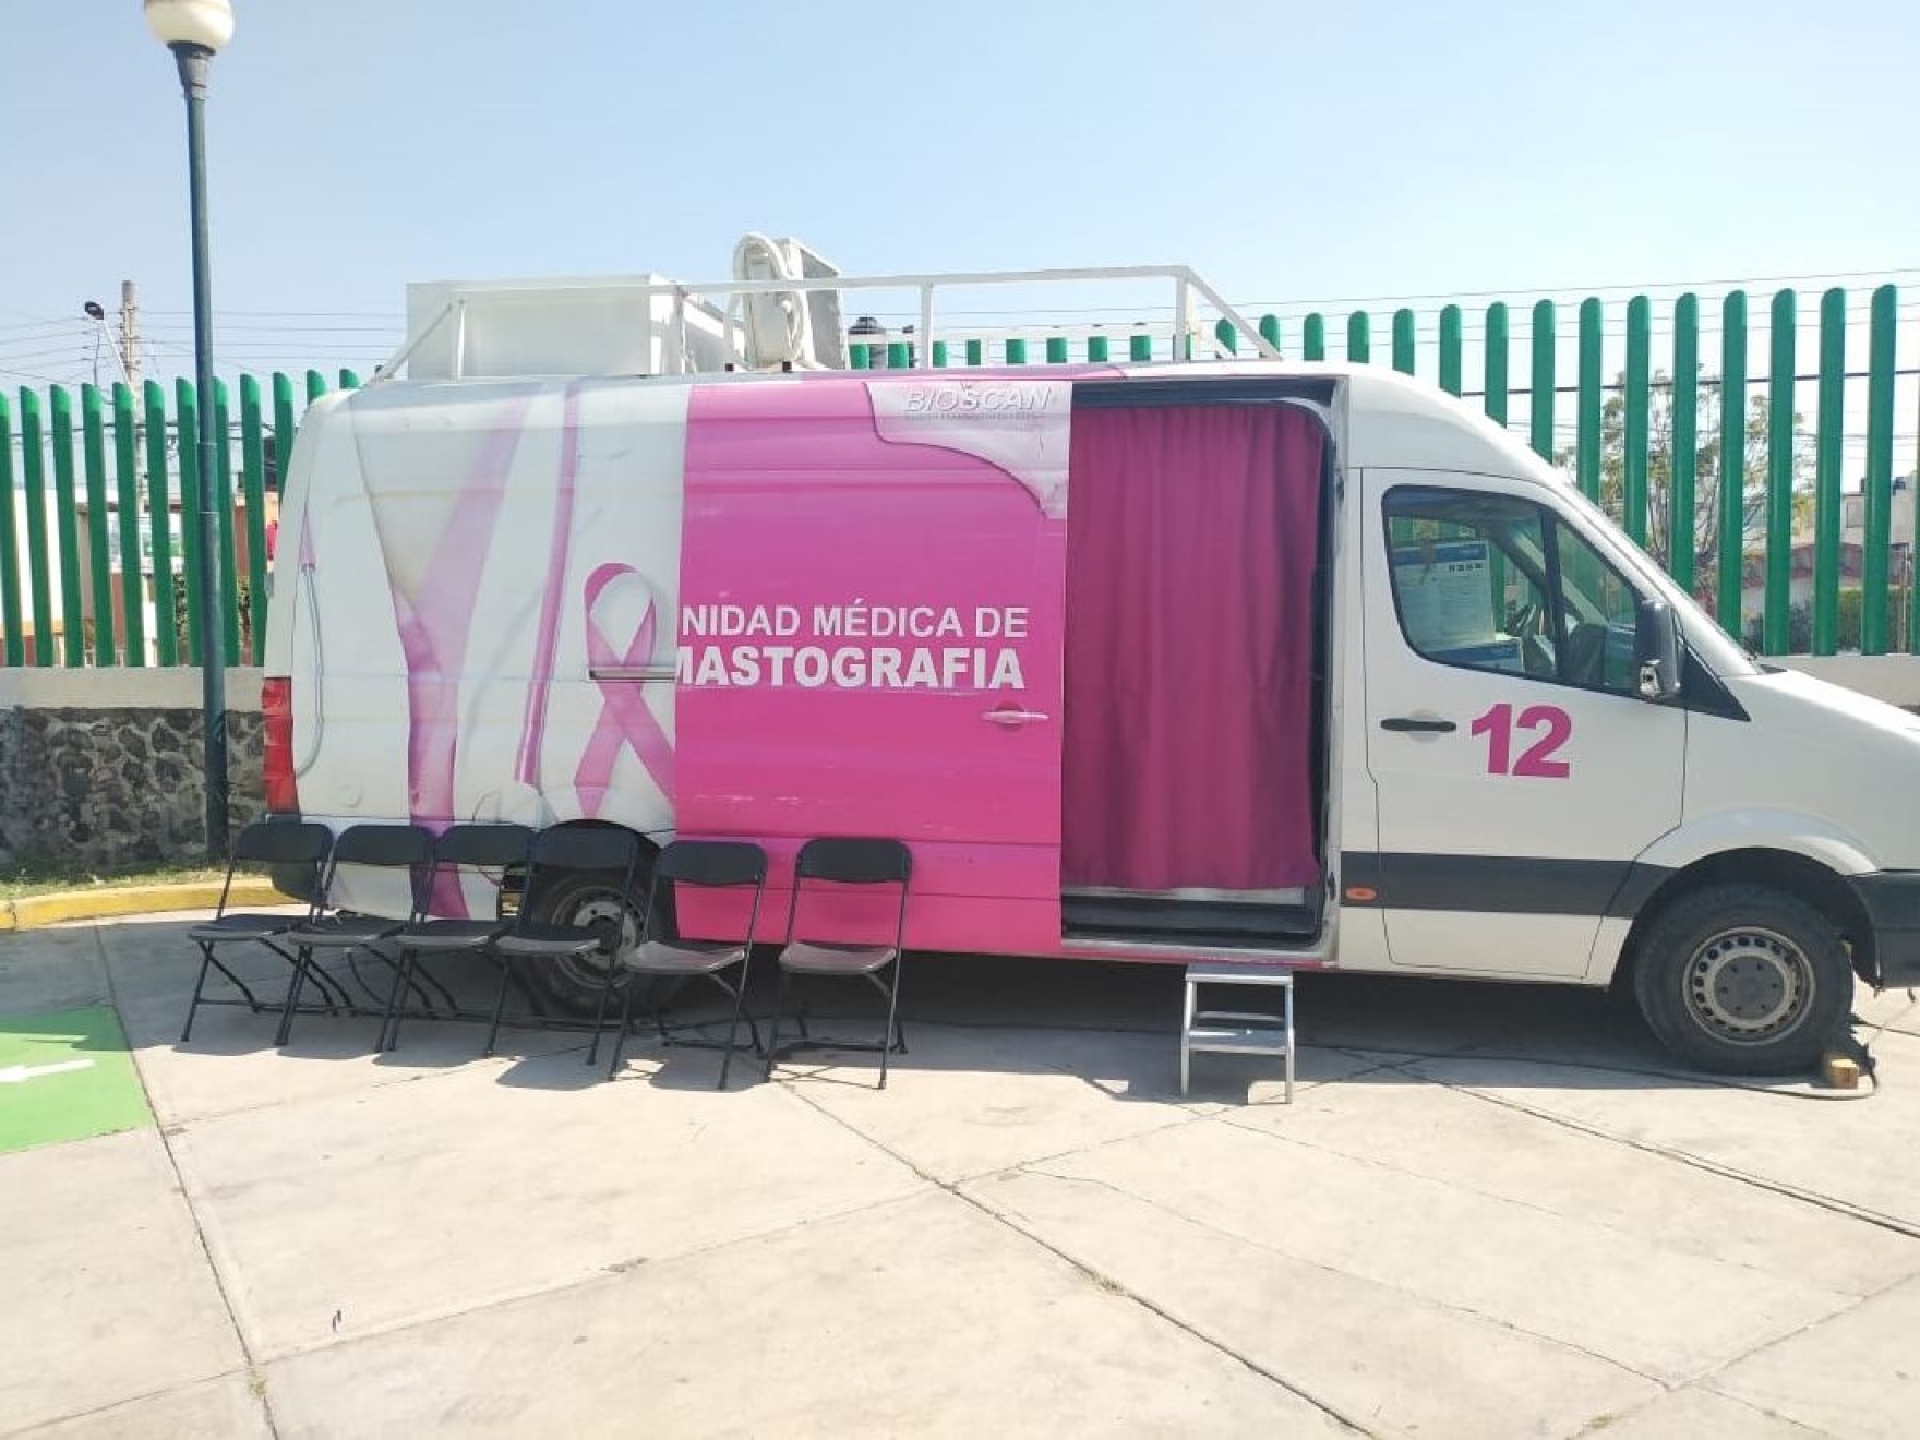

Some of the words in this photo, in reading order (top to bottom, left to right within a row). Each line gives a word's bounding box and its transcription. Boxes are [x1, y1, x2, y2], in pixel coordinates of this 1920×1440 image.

[905, 384, 1052, 412] BIOSCAN
[813, 598, 963, 637] MÉDICA
[975, 607, 1030, 637] DE
[1471, 703, 1572, 778] 12
